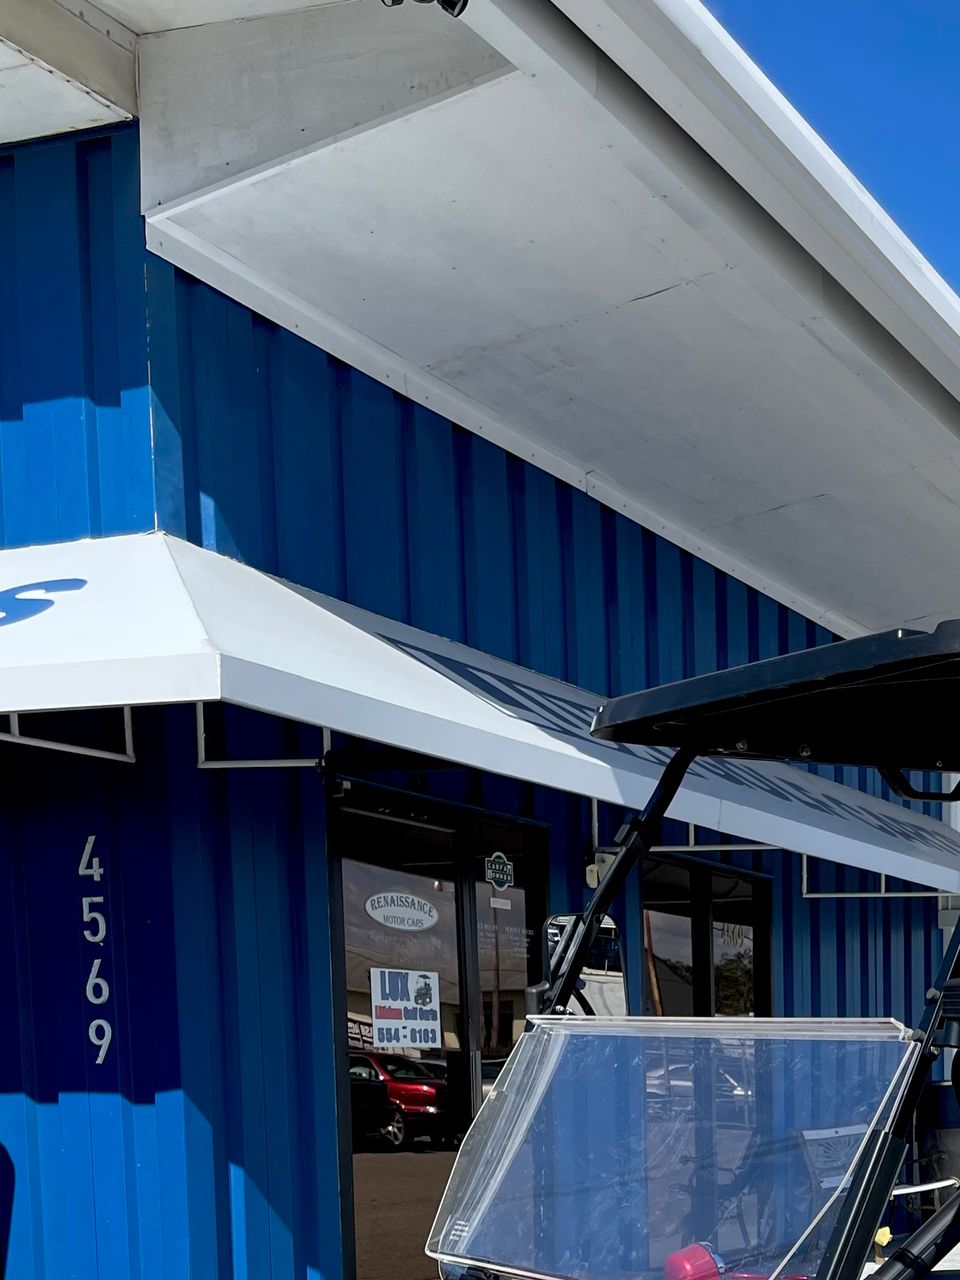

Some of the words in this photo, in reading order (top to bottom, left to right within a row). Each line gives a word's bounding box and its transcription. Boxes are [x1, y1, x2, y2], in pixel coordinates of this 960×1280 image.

[369, 895, 434, 918] RENAISSANCE
[383, 914, 406, 926] MOTOR
[407, 916, 424, 928] CARS
[379, 970, 411, 1002] LUX
